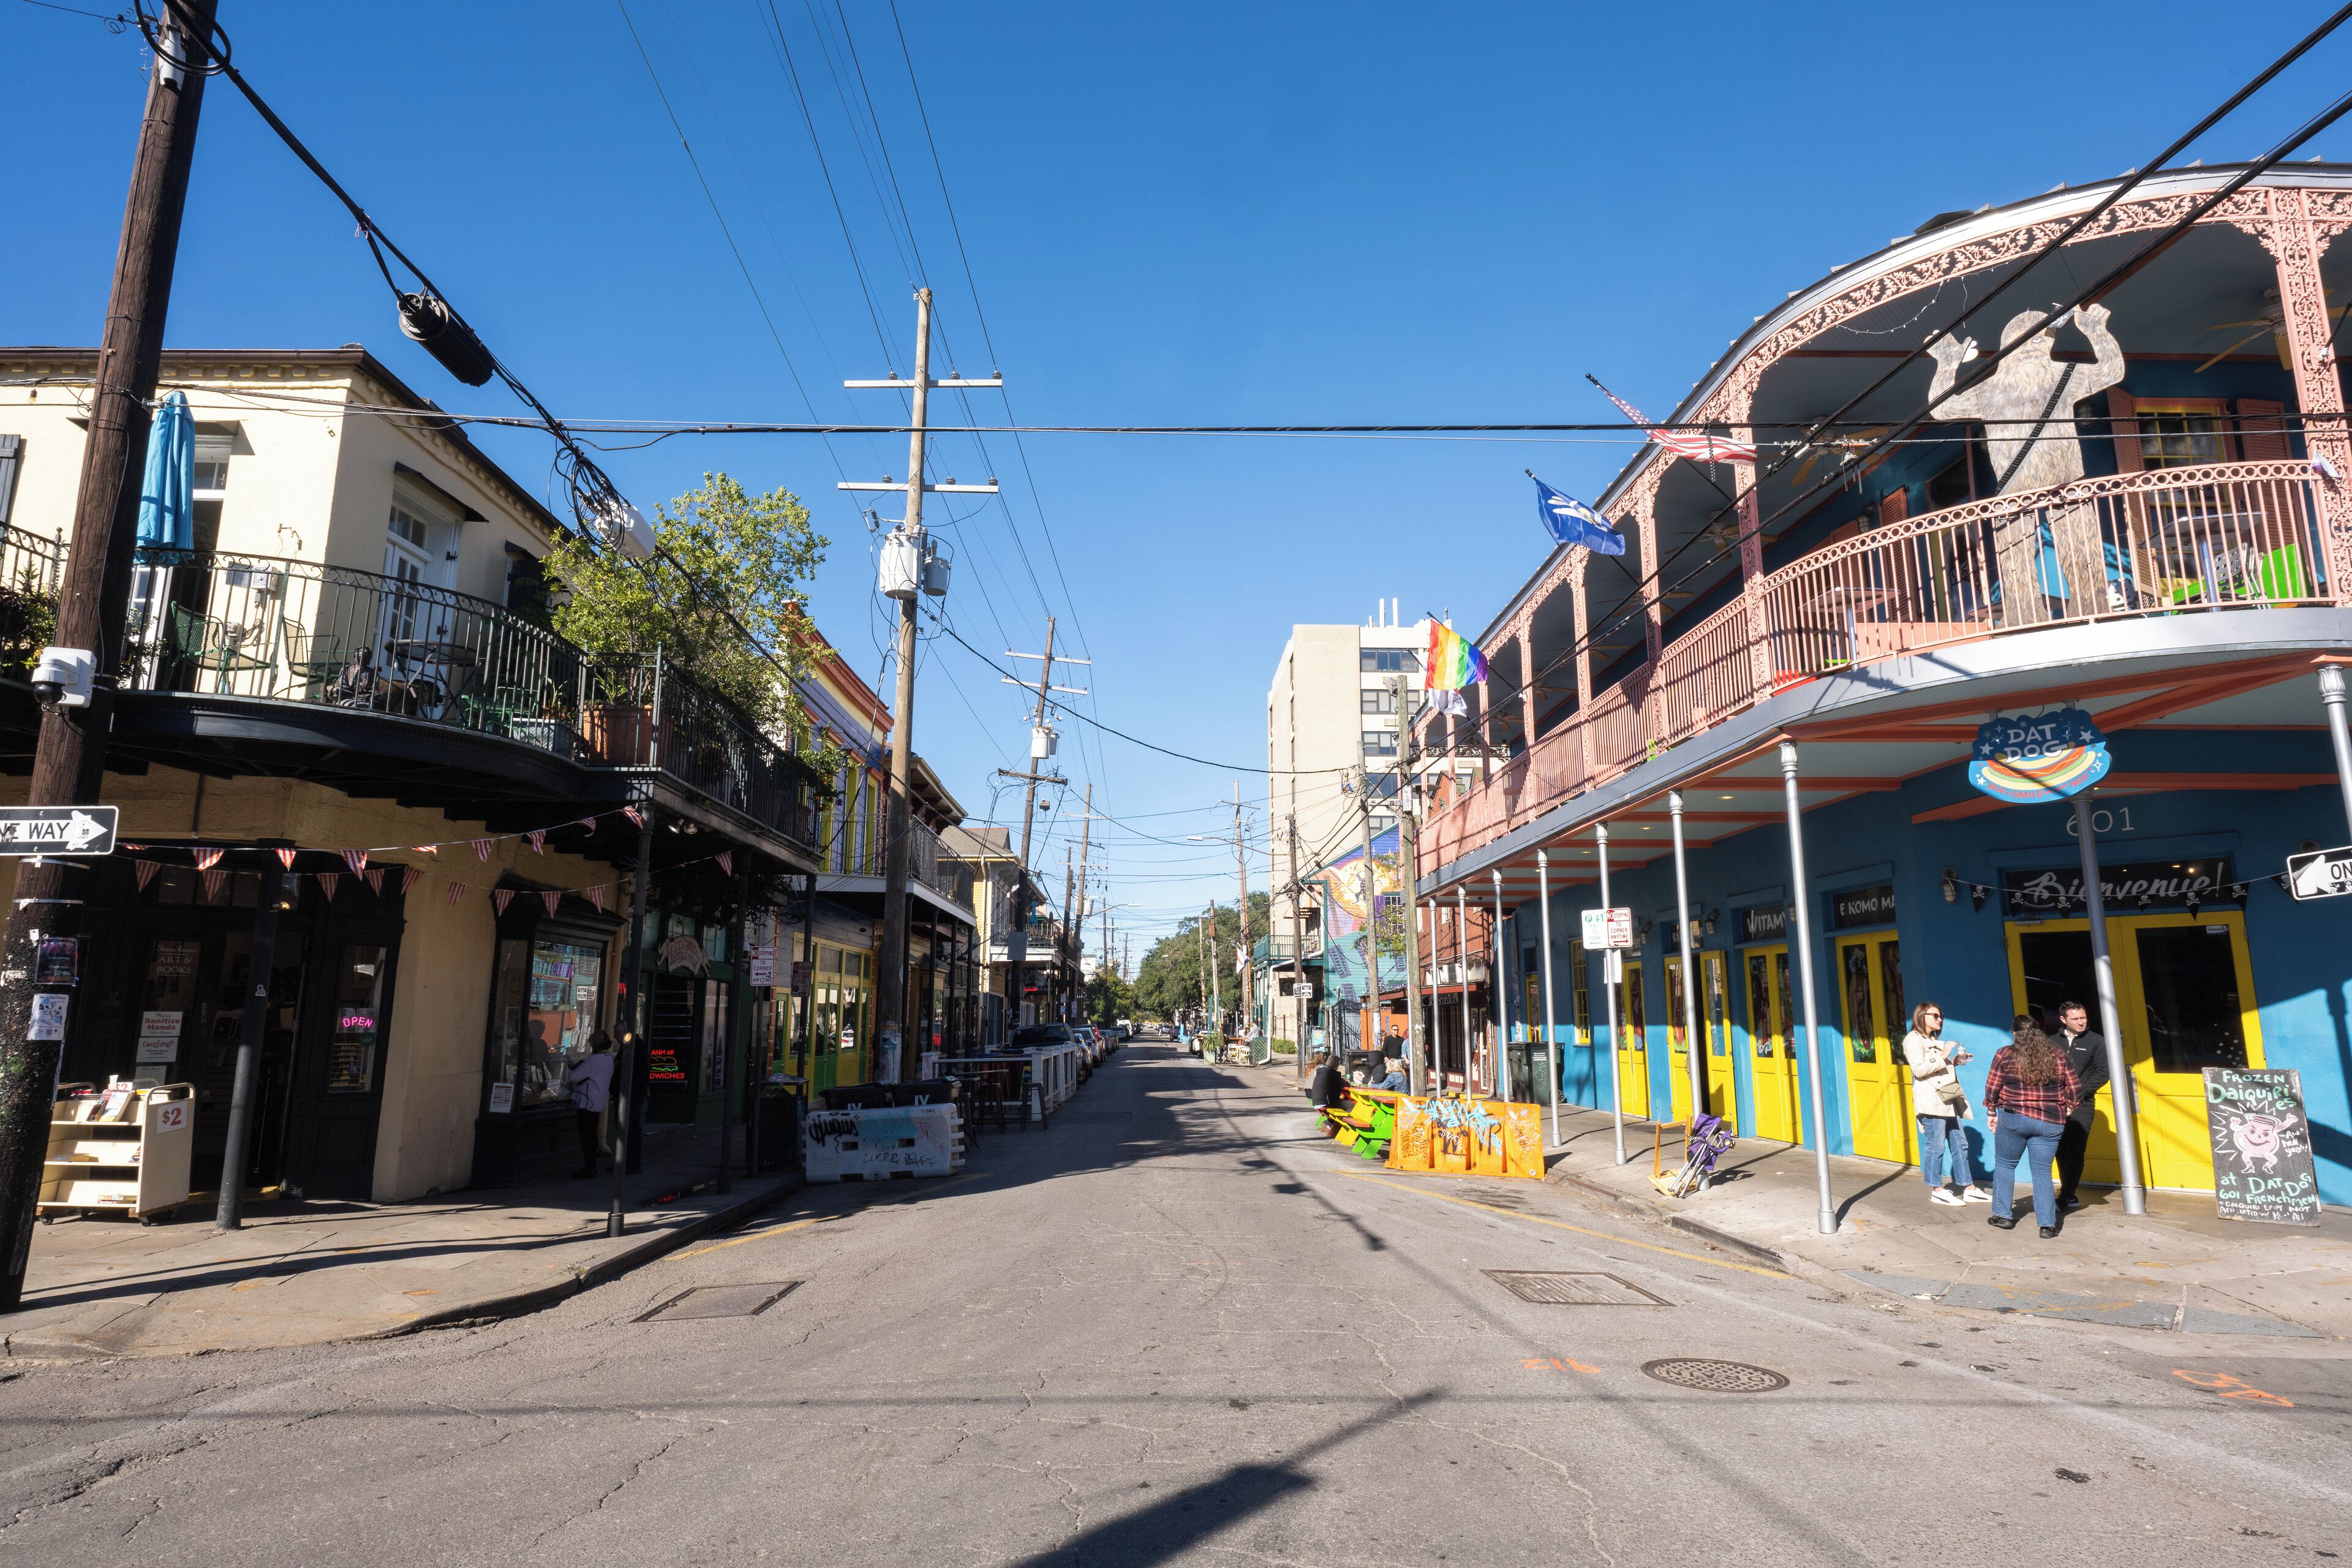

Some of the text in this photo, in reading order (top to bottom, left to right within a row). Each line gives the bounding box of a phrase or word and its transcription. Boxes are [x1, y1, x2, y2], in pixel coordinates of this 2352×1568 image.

[2007, 723, 2056, 744] DAT
[2003, 740, 2068, 764] DOG
[2013, 790, 2044, 799] SMILE
[0, 823, 70, 840] NE WAY
[2331, 861, 2352, 880] ON
[2024, 862, 2225, 909] Binvenue!
[1839, 903, 1845, 916] E
[1849, 897, 1879, 915] KOMO
[342, 1016, 373, 1028] OPEN
[2221, 1070, 2285, 1084] FROZEN
[2275, 1098, 2297, 1110] es
[162, 1107, 182, 1126] $2
[2219, 1189, 2240, 1199] 601
[2220, 1172, 2312, 1197] at DAT DOG
